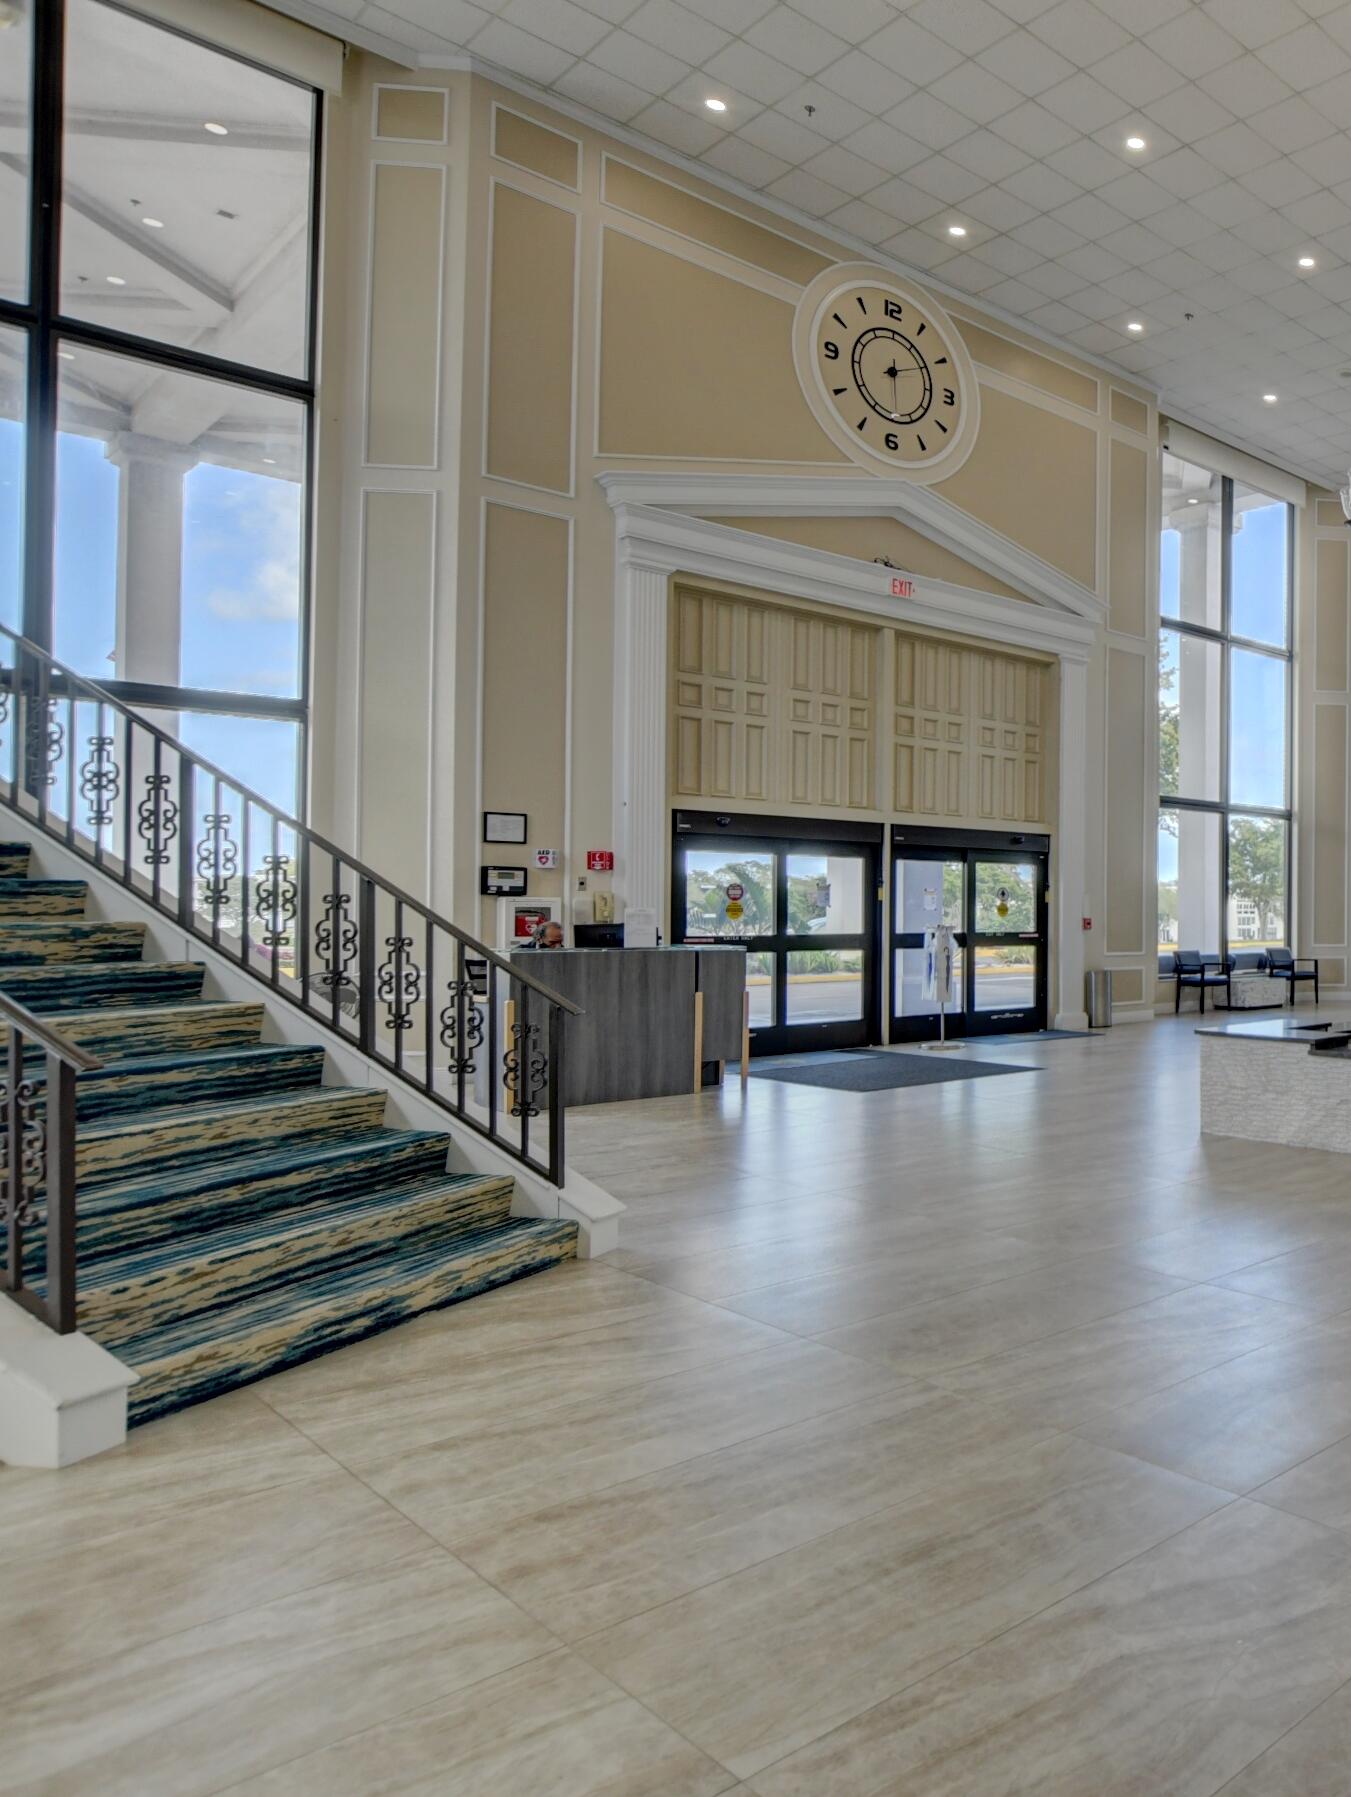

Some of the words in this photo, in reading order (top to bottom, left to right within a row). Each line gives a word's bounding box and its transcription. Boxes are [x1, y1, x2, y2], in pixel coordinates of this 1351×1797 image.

[884, 299, 902, 322] 12
[824, 341, 840, 360] 9
[943, 388, 955, 406] 3
[884, 433, 899, 450] 6
[892, 578, 913, 597] EXIT
